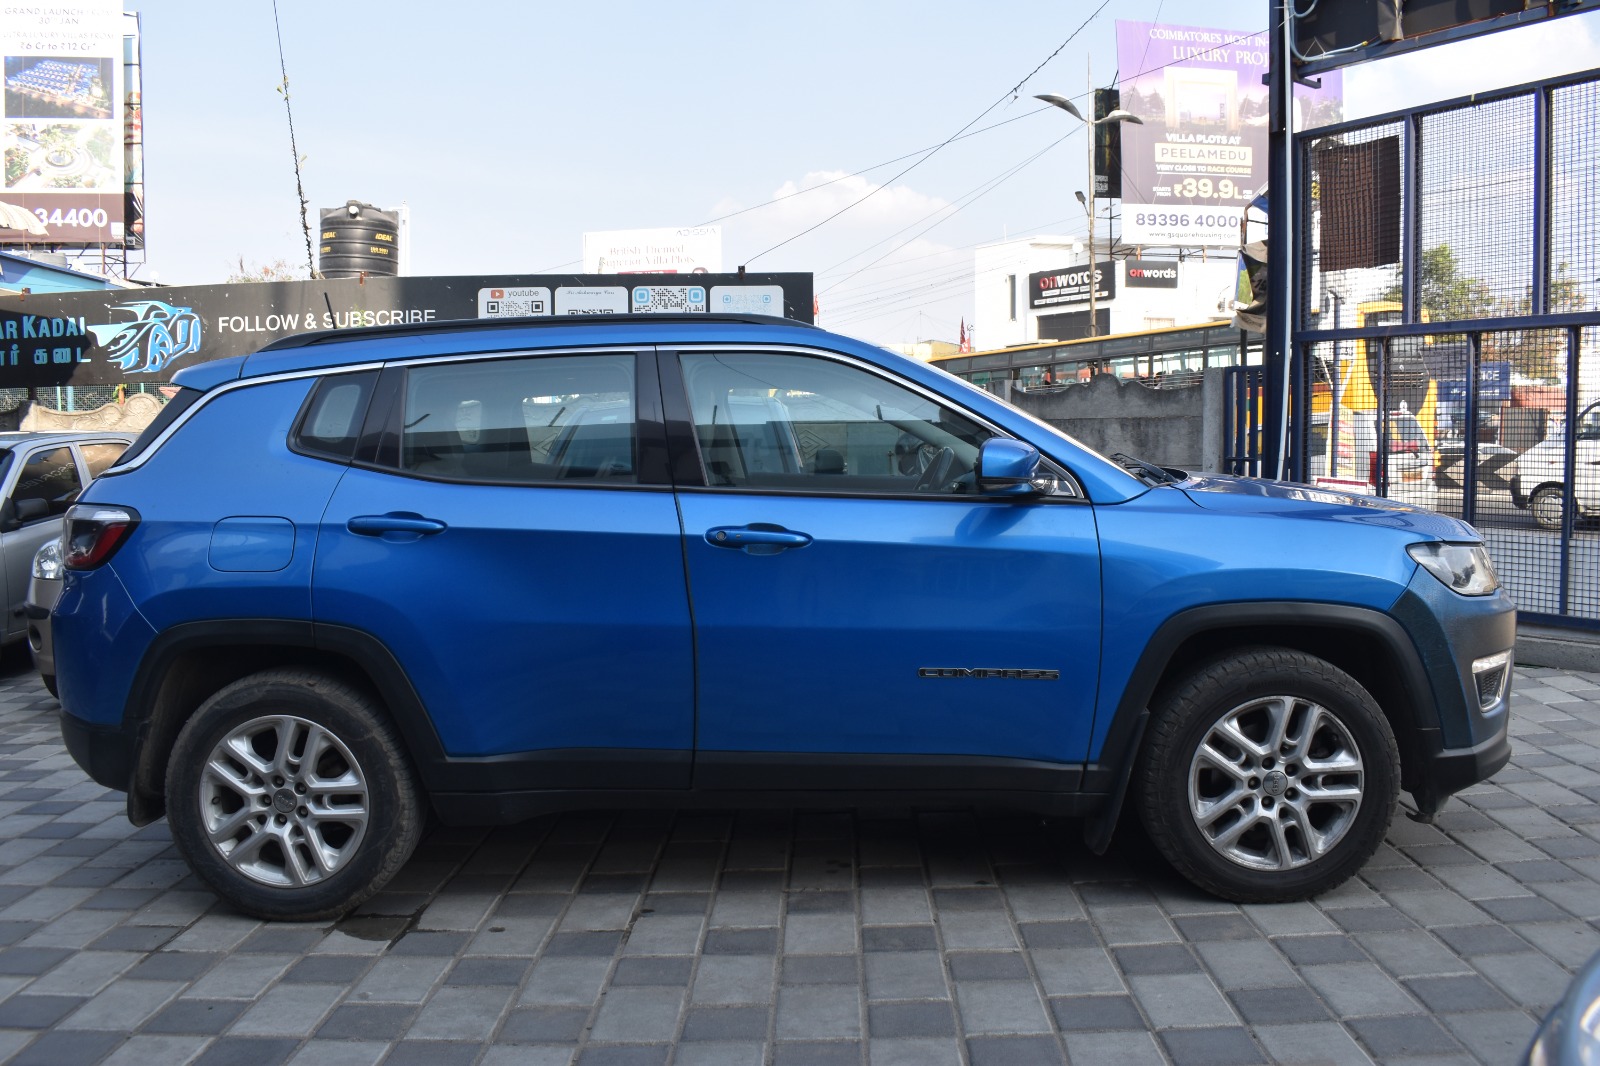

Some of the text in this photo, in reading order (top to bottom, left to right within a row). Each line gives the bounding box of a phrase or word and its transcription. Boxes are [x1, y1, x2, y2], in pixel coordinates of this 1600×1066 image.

[5, 8, 41, 16] GRAND
[44, 8, 84, 16] LAUNCH
[36, 41, 46, 50] Cr
[48, 42, 58, 50] to
[1224, 34, 1252, 46] MOST
[1254, 36, 1269, 47] IN-
[1172, 46, 1268, 68] LUXURY PROJ
[1166, 132, 1242, 145] VILLA PLOTS AT
[1161, 147, 1247, 161] PEELAMEDU
[1175, 164, 1197, 172] CLOSE
[1226, 166, 1252, 174] COURSE
[35, 208, 108, 228] 34400
[1136, 213, 1238, 228] 89396 4000
[375, 233, 393, 241] IDEAL
[610, 246, 641, 256] British
[645, 256, 669, 266] Villa
[671, 255, 696, 266] Plots
[1129, 268, 1176, 279] onwords
[508, 289, 539, 299] youtube
[22, 315, 86, 339] KADAI
[218, 310, 436, 333] FOLLOW & SUBSCRIBE
[918, 667, 1060, 680] COMPASS
